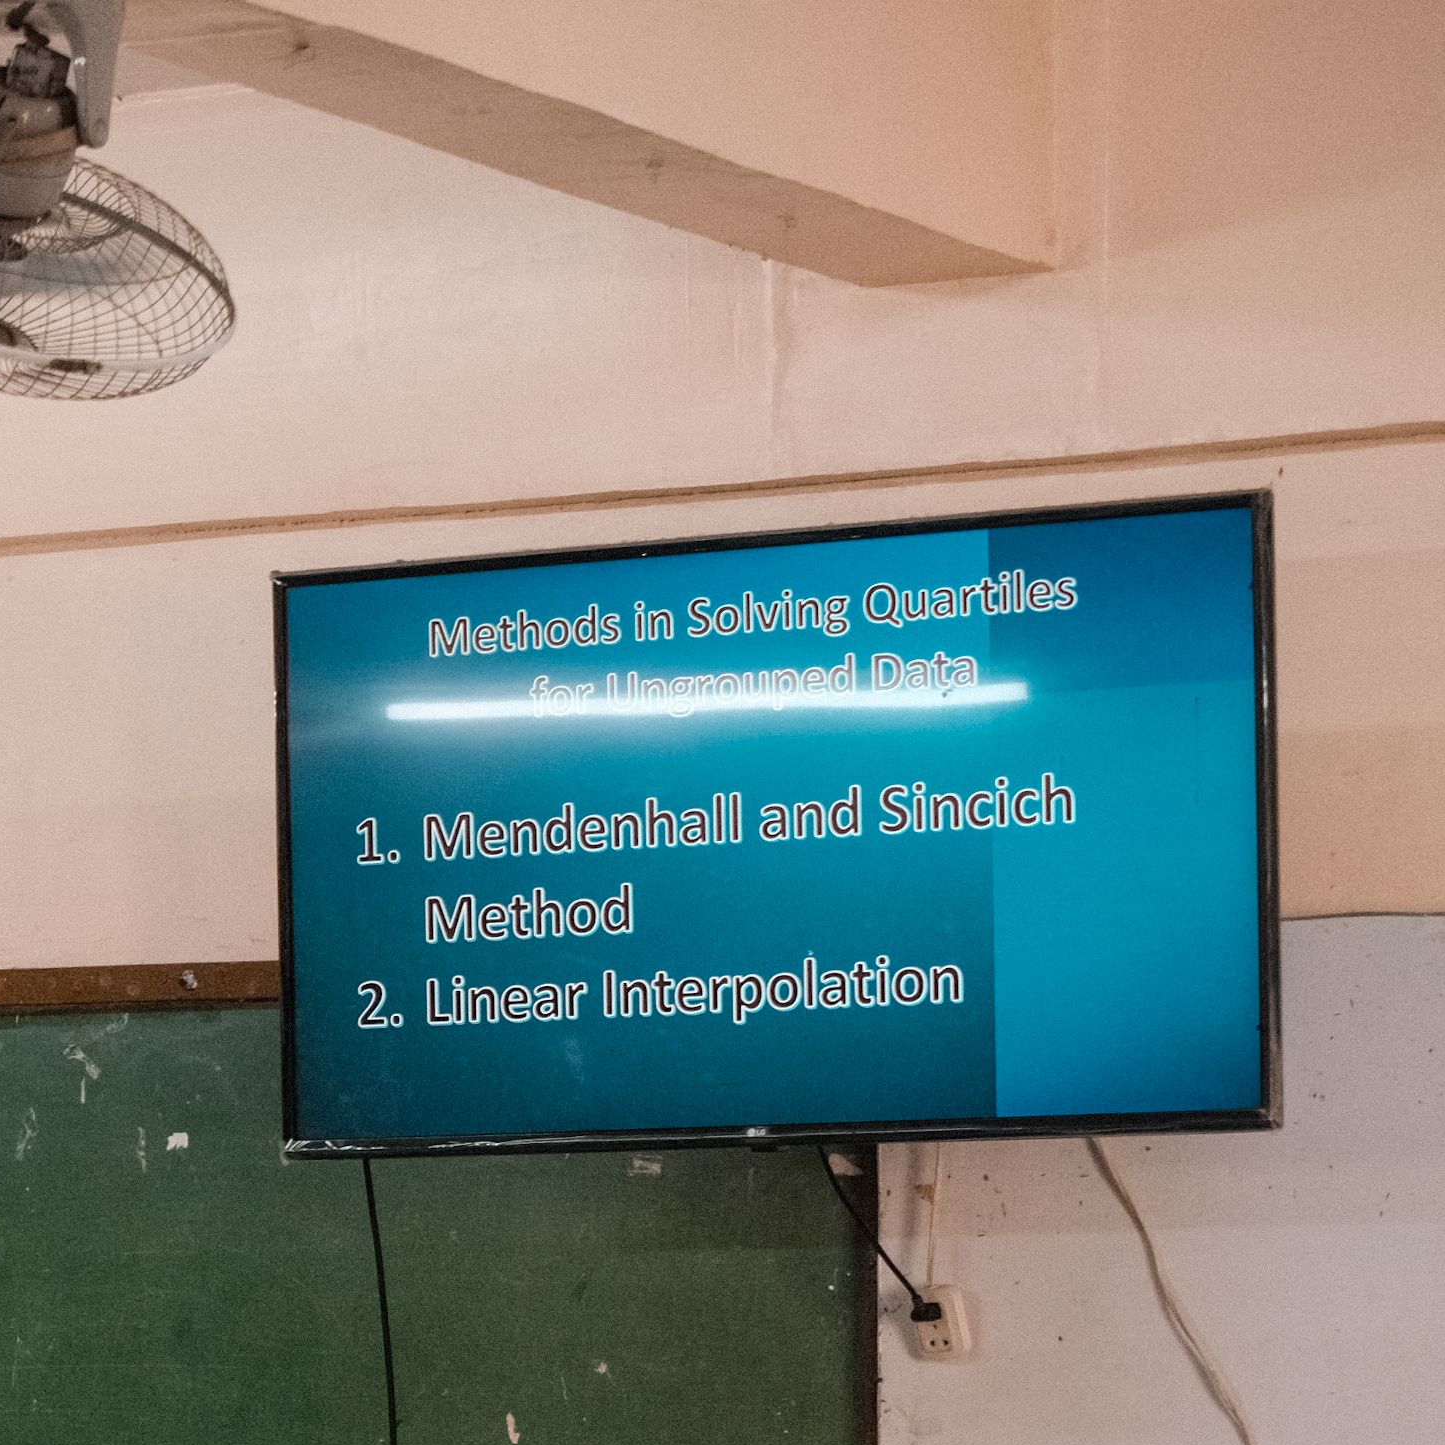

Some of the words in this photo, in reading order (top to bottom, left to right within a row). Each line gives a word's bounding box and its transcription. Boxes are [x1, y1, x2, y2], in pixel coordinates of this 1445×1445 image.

[428, 603, 621, 657] Methods
[634, 601, 674, 641] in
[688, 590, 849, 637] Solving
[863, 568, 1078, 627] Quartiles
[529, 674, 593, 718] for
[606, 653, 856, 716] Ungrouped
[872, 651, 977, 692] Data
[356, 817, 401, 864] 1.
[423, 792, 742, 861] Mendenhall
[758, 784, 862, 841] and
[879, 772, 1076, 834] Sincich
[424, 882, 634, 944] Method
[357, 980, 404, 1028] 2.
[426, 975, 588, 1026] Linear
[603, 955, 964, 1025] Interpolation
